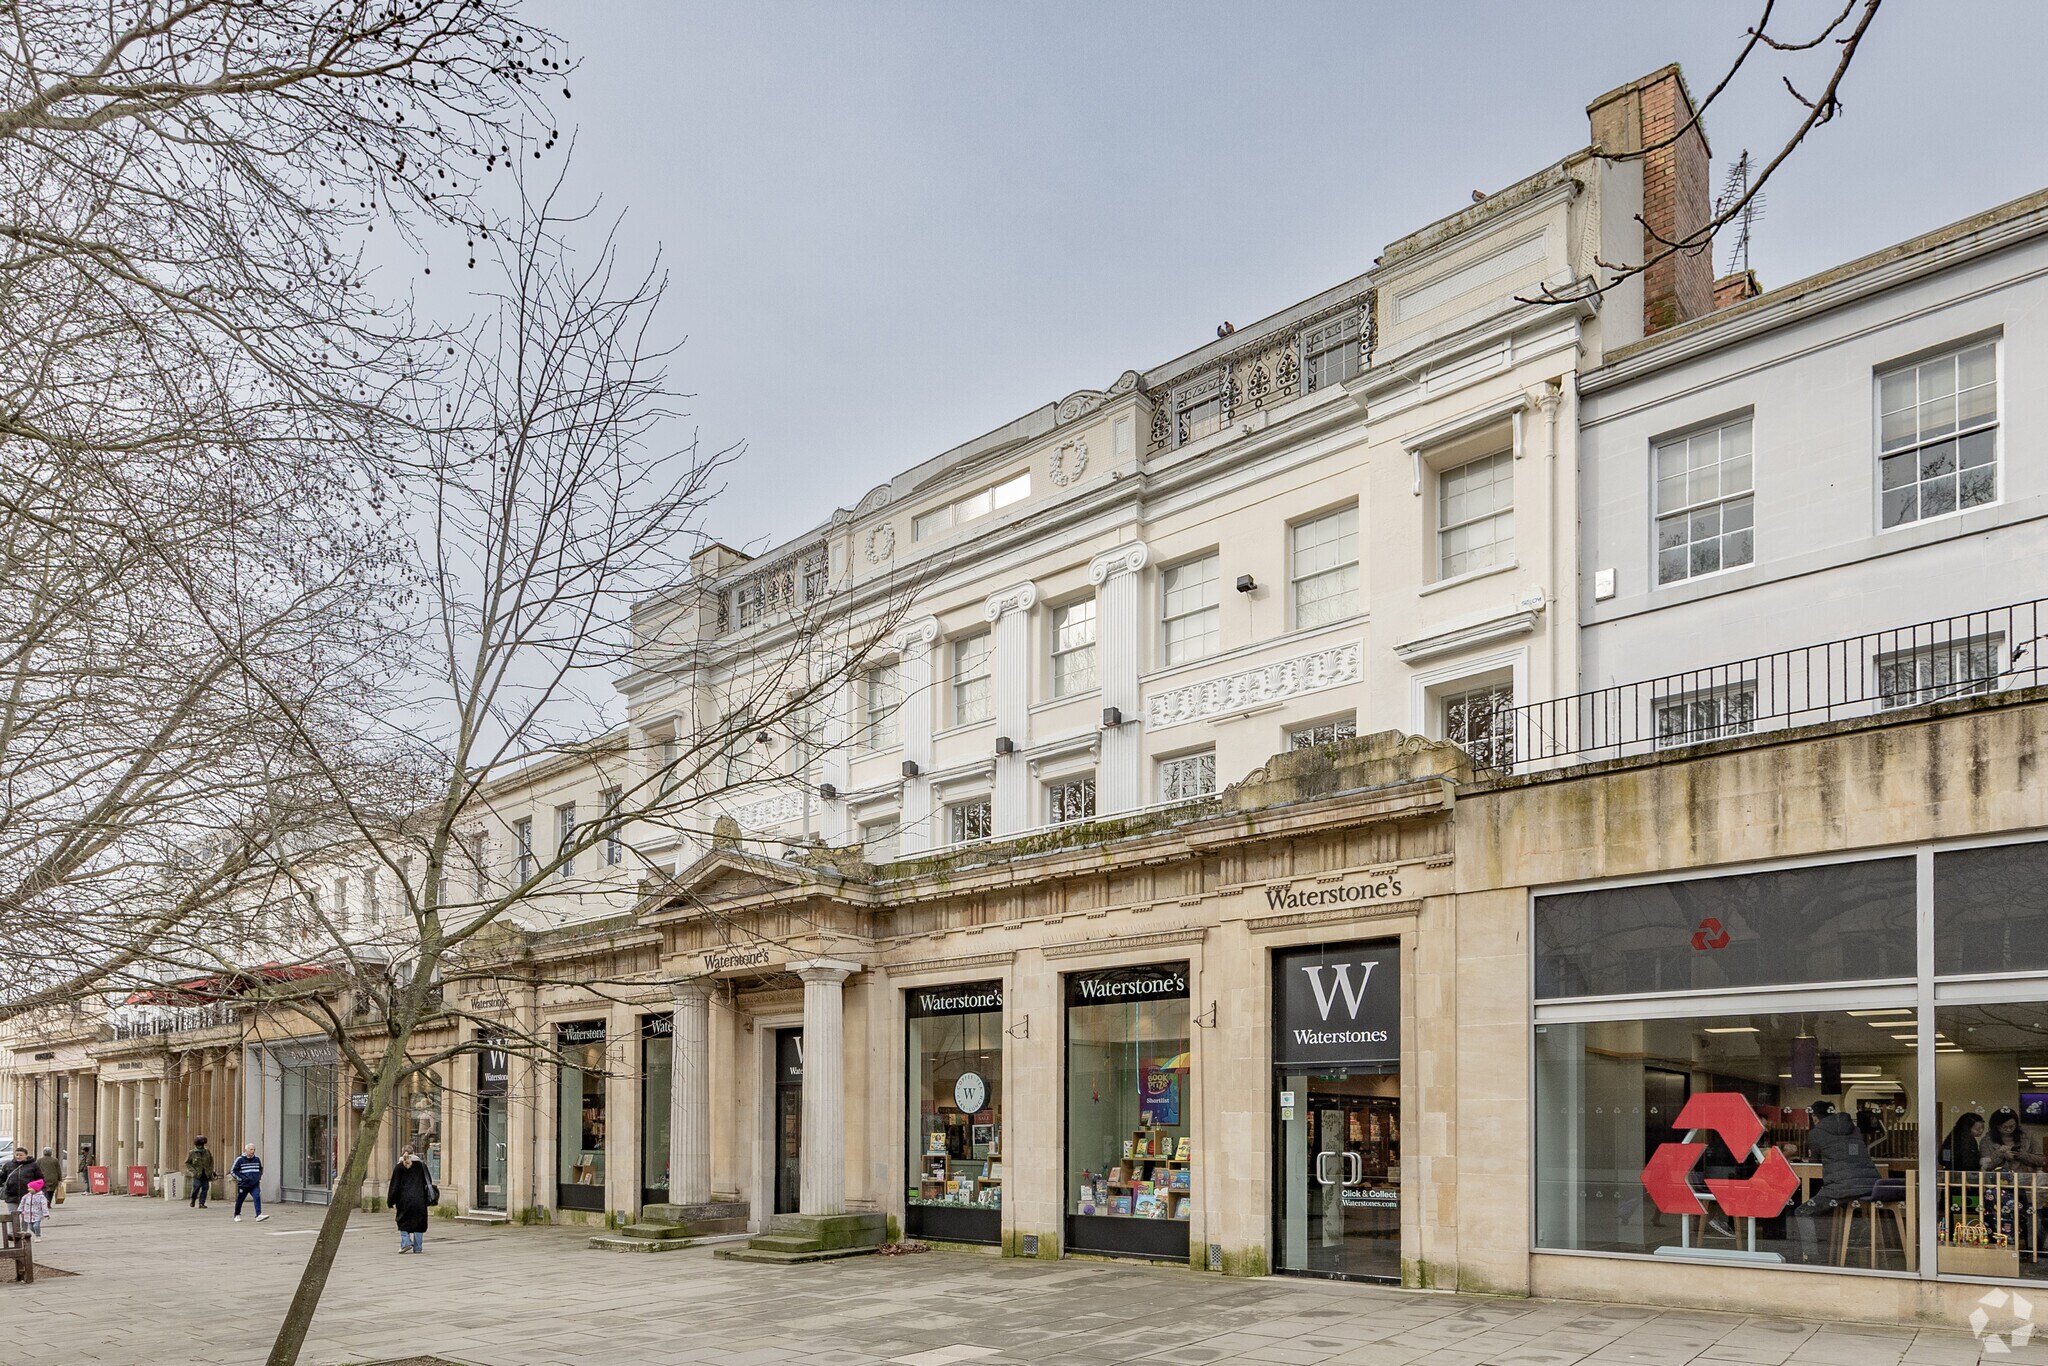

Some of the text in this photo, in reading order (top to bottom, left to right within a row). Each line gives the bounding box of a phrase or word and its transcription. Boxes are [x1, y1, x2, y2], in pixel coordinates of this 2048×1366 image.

[1264, 875, 1402, 911] Waterstone's
[704, 948, 769, 970] Waterstone's
[1079, 973, 1185, 999] Waterstone's
[1302, 961, 1379, 1021] W
[919, 989, 1002, 1011] Waterstone's
[1293, 1029, 1388, 1045] Waterstones
[957, 1074, 974, 1090] COFFEE
[1147, 1073, 1169, 1083] BOOK
[963, 1087, 976, 1100] W
[1341, 1189, 1397, 1199] Click & Collect
[1342, 1199, 1397, 1208] Waterstones.com
